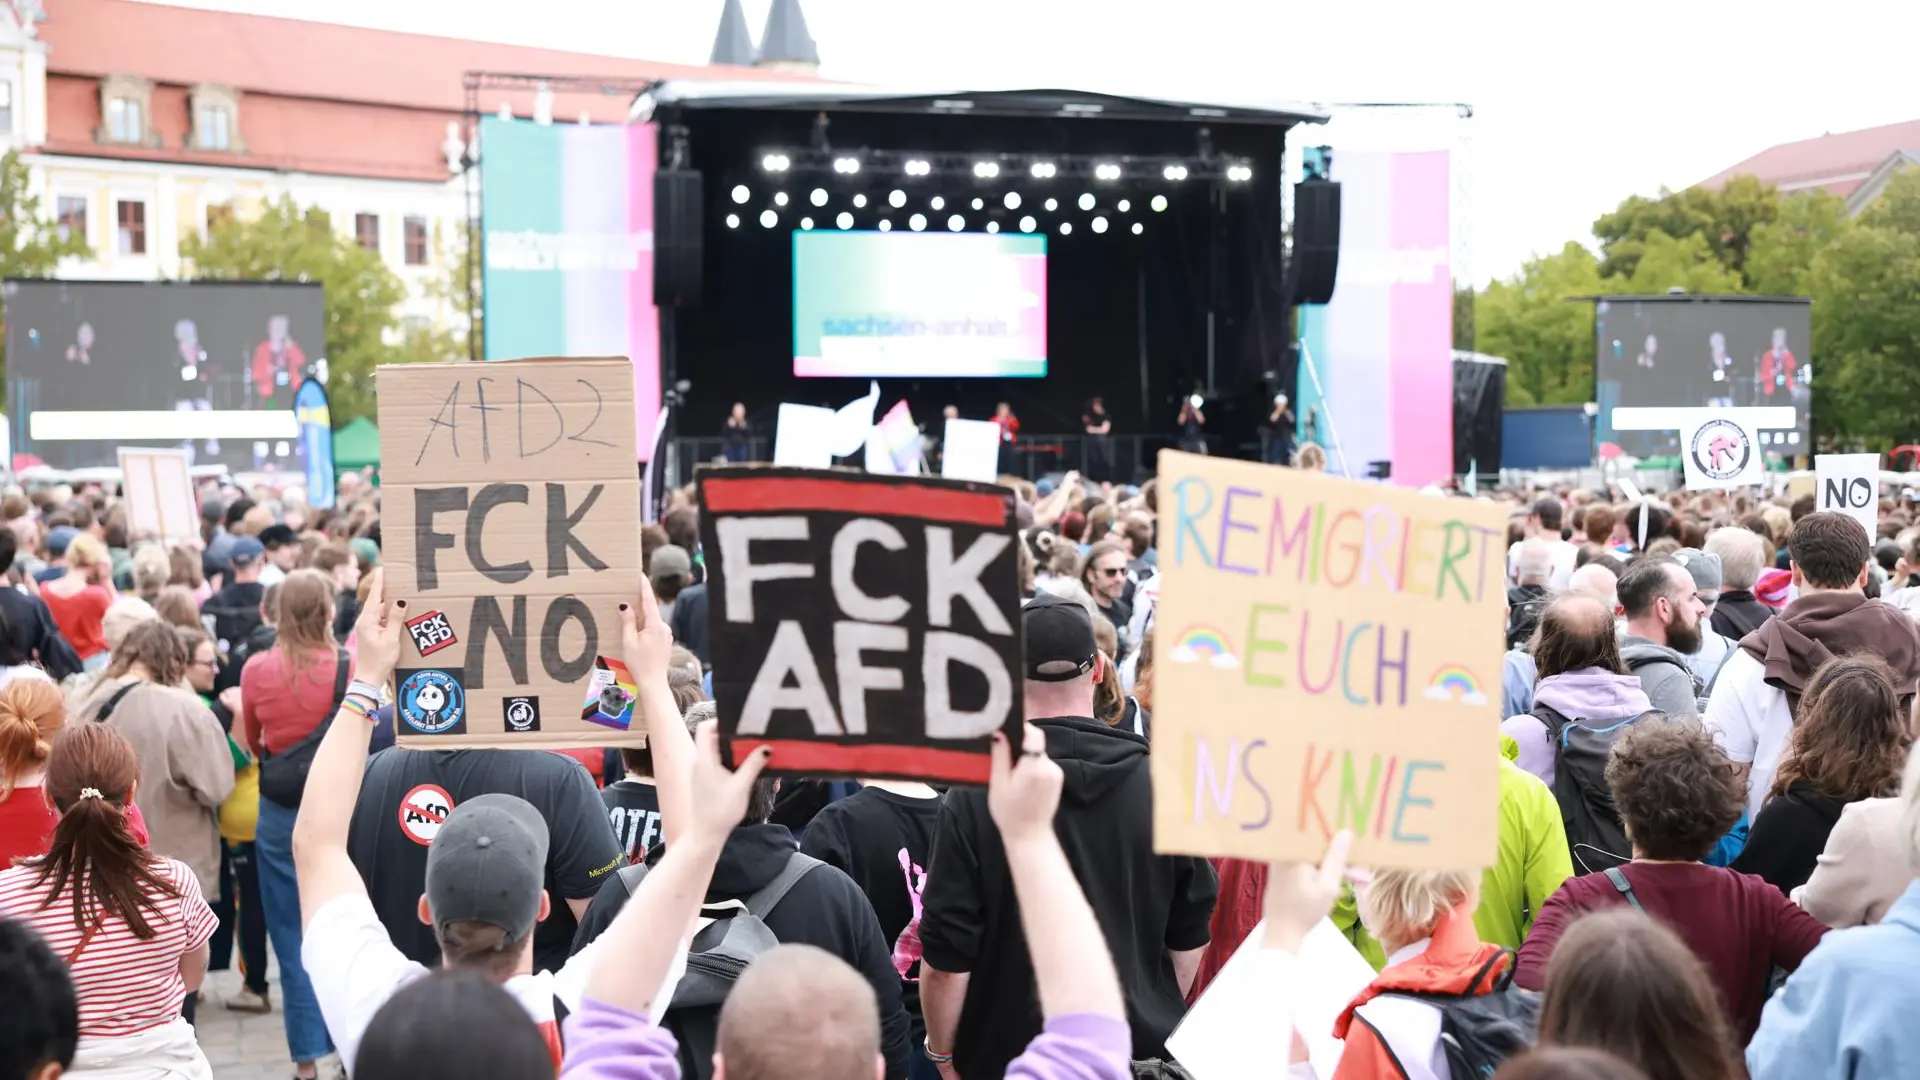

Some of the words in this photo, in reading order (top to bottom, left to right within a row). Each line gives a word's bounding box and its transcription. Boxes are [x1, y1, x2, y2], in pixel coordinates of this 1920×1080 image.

[414, 483, 609, 592] FCK
[1173, 476, 1502, 602] REMIGRIERT
[1825, 477, 1872, 509] NO
[716, 516, 1014, 636] FCK
[410, 614, 447, 639] FCK
[419, 626, 452, 650] AFD
[463, 594, 599, 690] NO
[1244, 603, 1409, 707] EUCH
[736, 620, 1012, 739] AFD
[406, 803, 449, 824] AfD
[1298, 743, 1446, 843] KNIE
